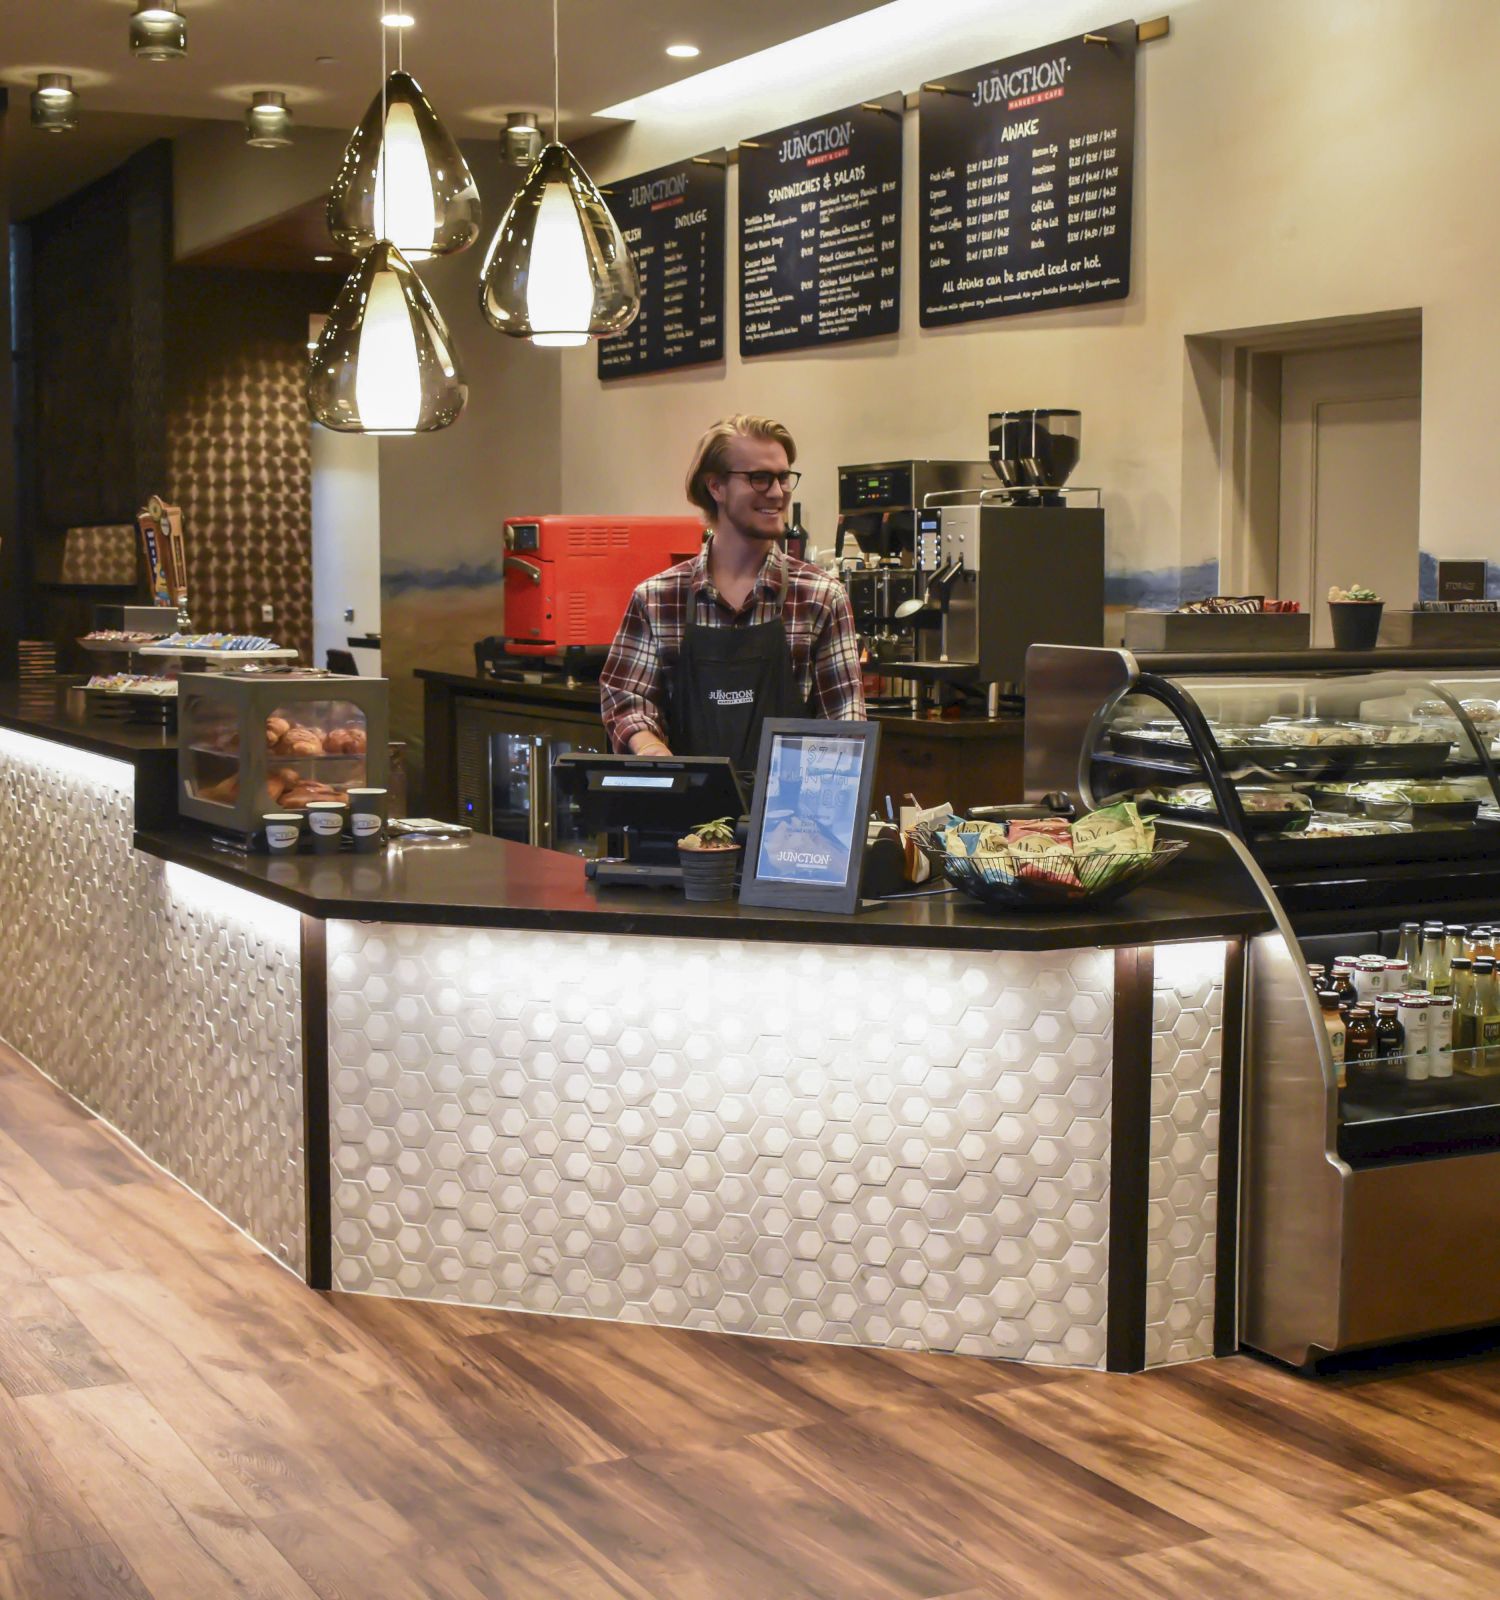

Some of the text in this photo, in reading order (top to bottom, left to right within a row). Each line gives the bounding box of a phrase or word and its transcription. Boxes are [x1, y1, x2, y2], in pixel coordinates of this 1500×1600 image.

[973, 57, 1066, 107] JUNCTION
[1008, 96, 1035, 109] MARKET
[779, 121, 851, 163] JUNCTION
[1001, 118, 1039, 142] AWAKE
[630, 173, 686, 208] JUNCTION
[768, 165, 866, 204] SANDWICHES & SALADS
[675, 208, 708, 230] INDULGE
[942, 254, 1102, 294] All drinks can be served iced or hot.
[710, 690, 753, 700] JUNCTION
[777, 850, 830, 865] JUNCTION
